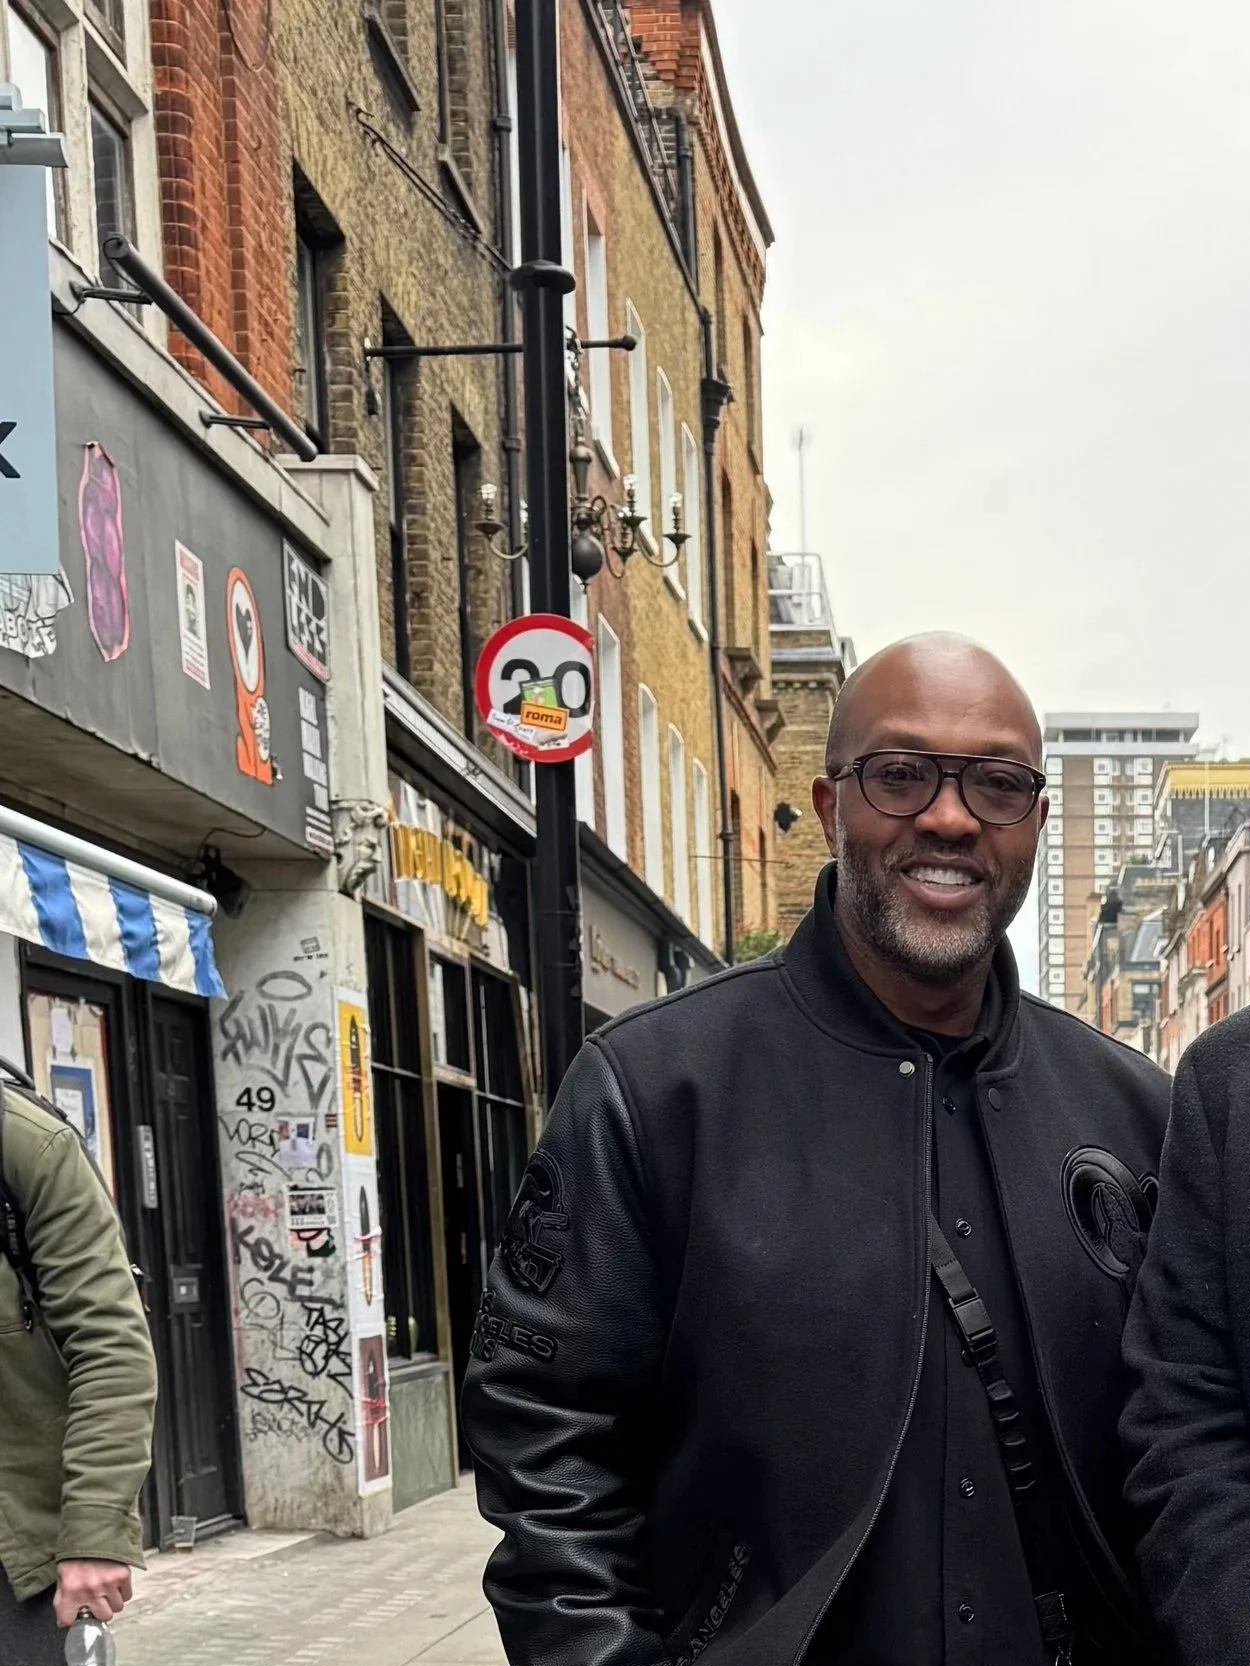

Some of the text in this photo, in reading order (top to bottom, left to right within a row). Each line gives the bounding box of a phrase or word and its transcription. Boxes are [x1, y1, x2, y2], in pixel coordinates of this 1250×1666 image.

[501, 658, 592, 718] 20
[525, 711, 562, 725] roma
[235, 1086, 276, 1112] 49
